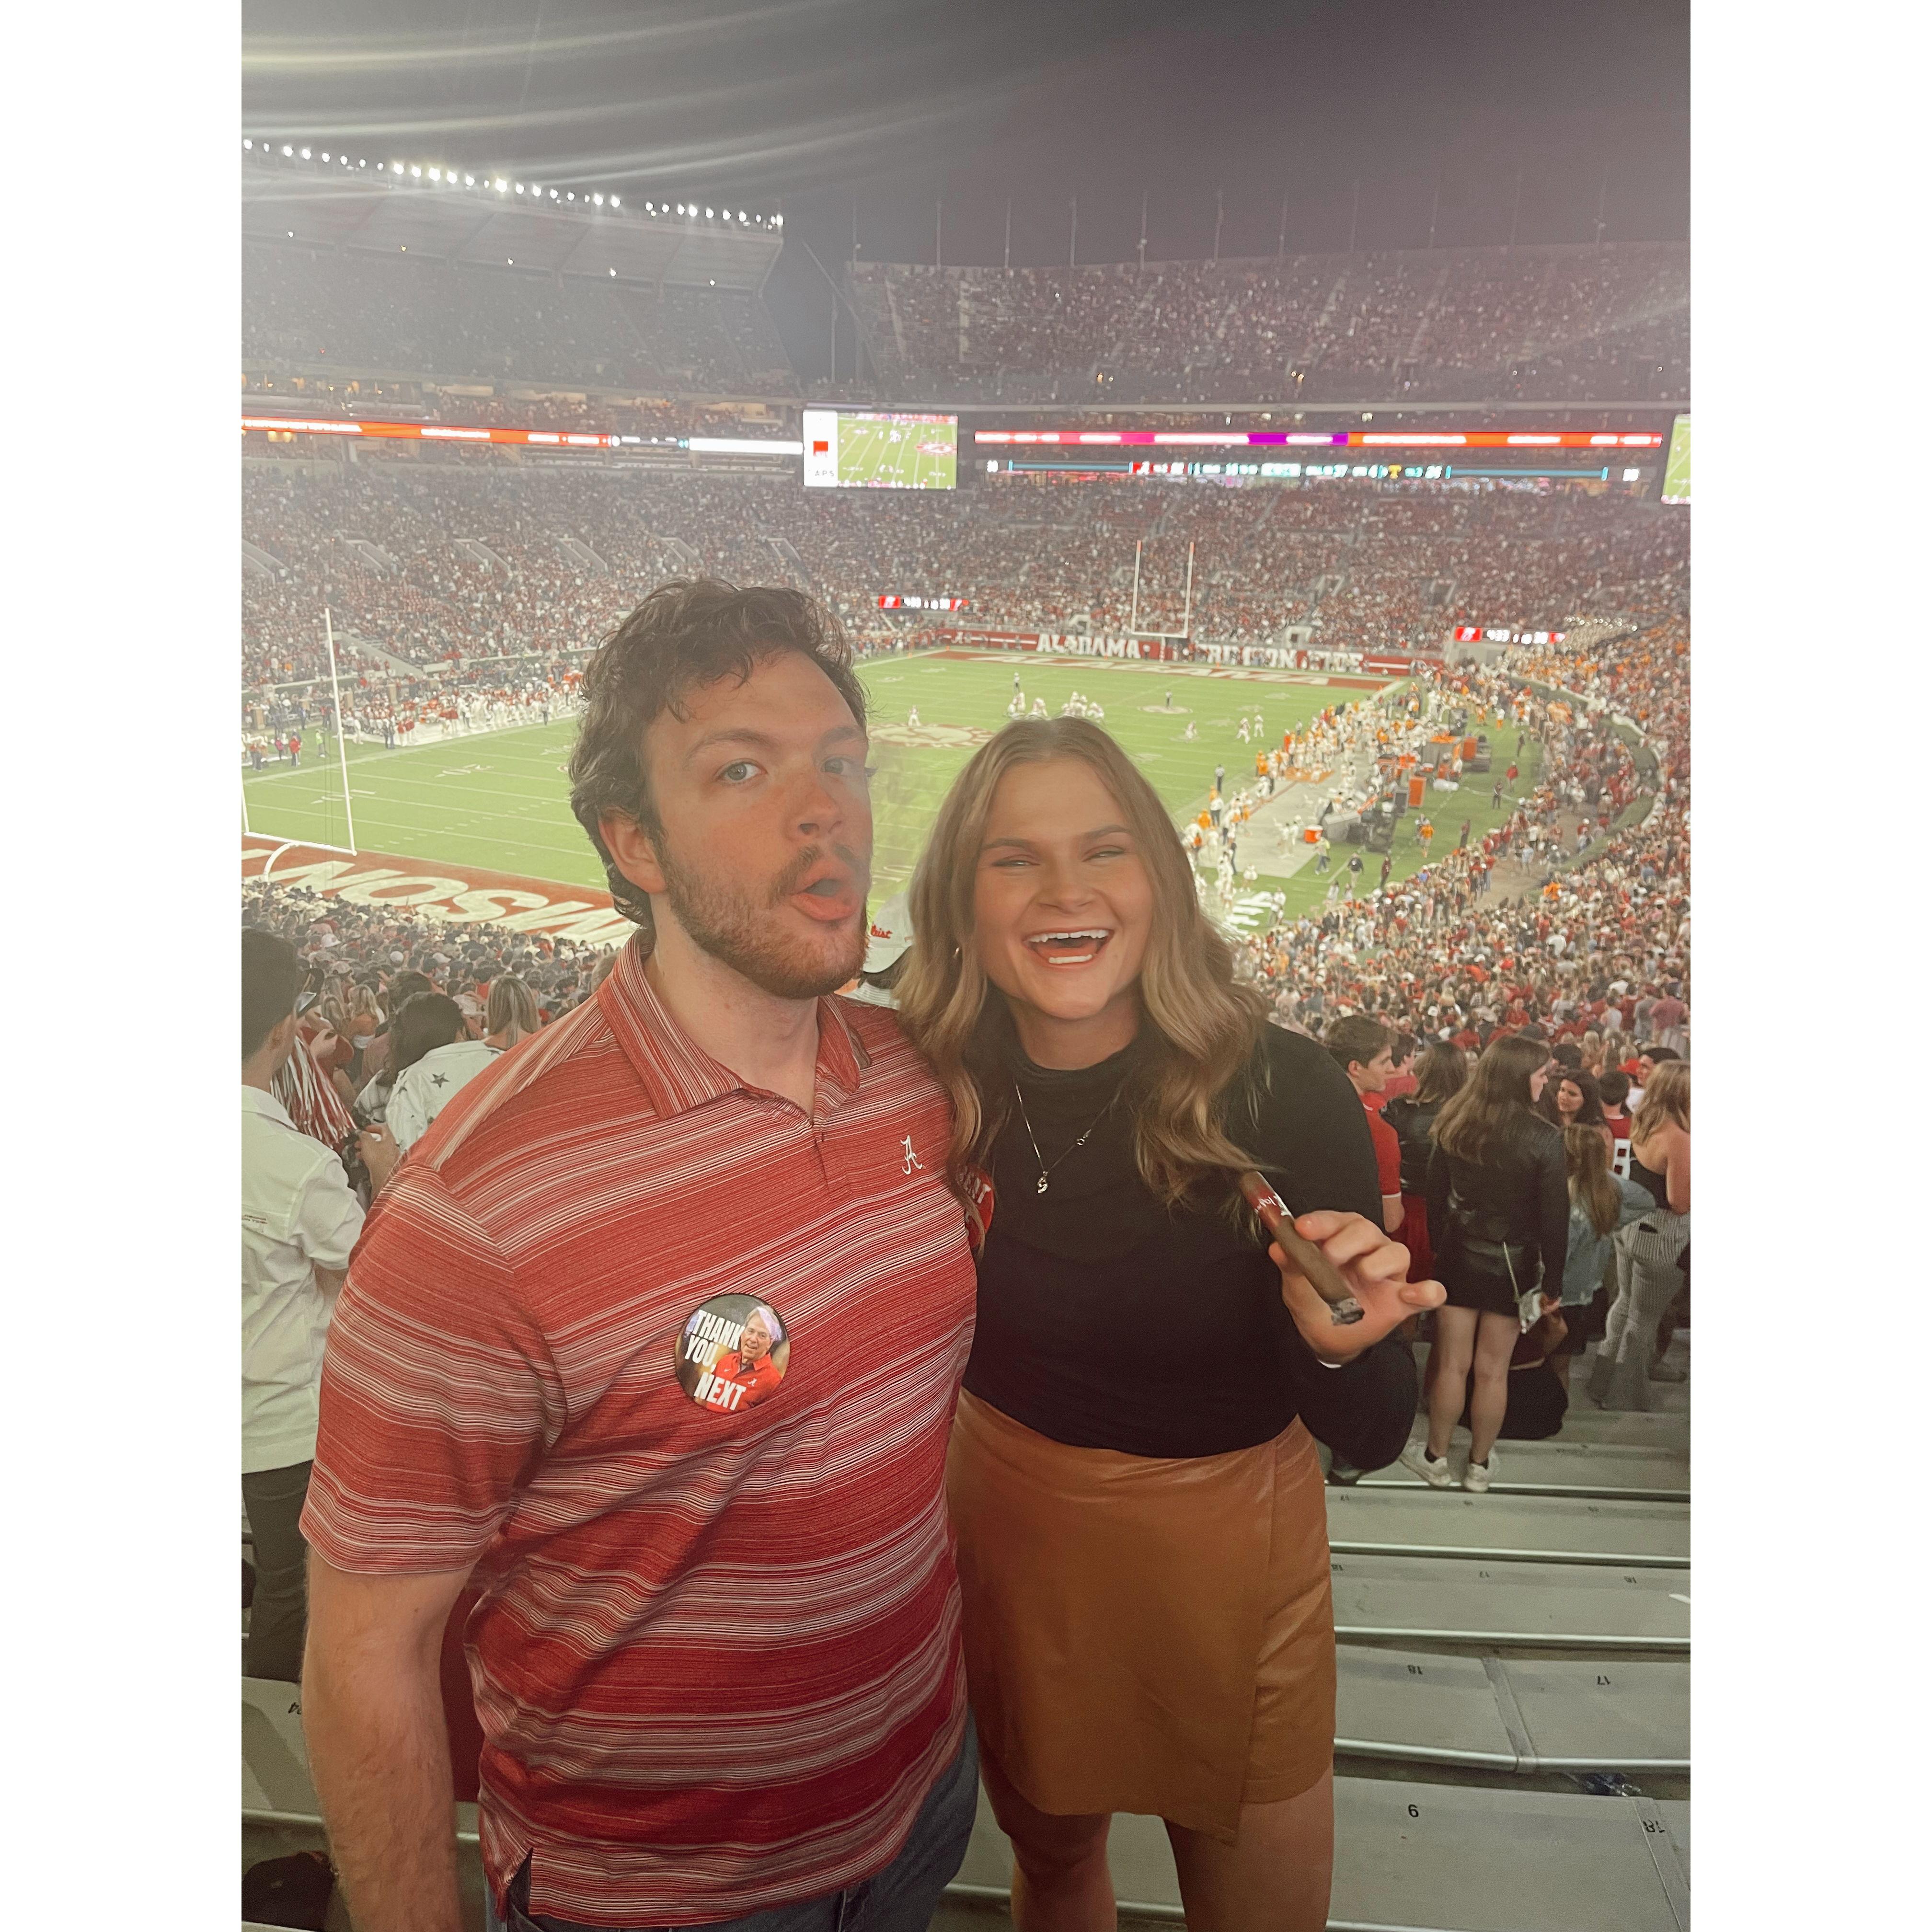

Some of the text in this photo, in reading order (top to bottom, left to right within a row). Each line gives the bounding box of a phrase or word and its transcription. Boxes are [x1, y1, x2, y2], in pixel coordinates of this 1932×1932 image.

[1195, 644, 1298, 668] RIMON
[691, 1309, 745, 1350] THANK
[693, 1372, 747, 1411] NEXT
[1596, 1675, 1610, 1686] 17
